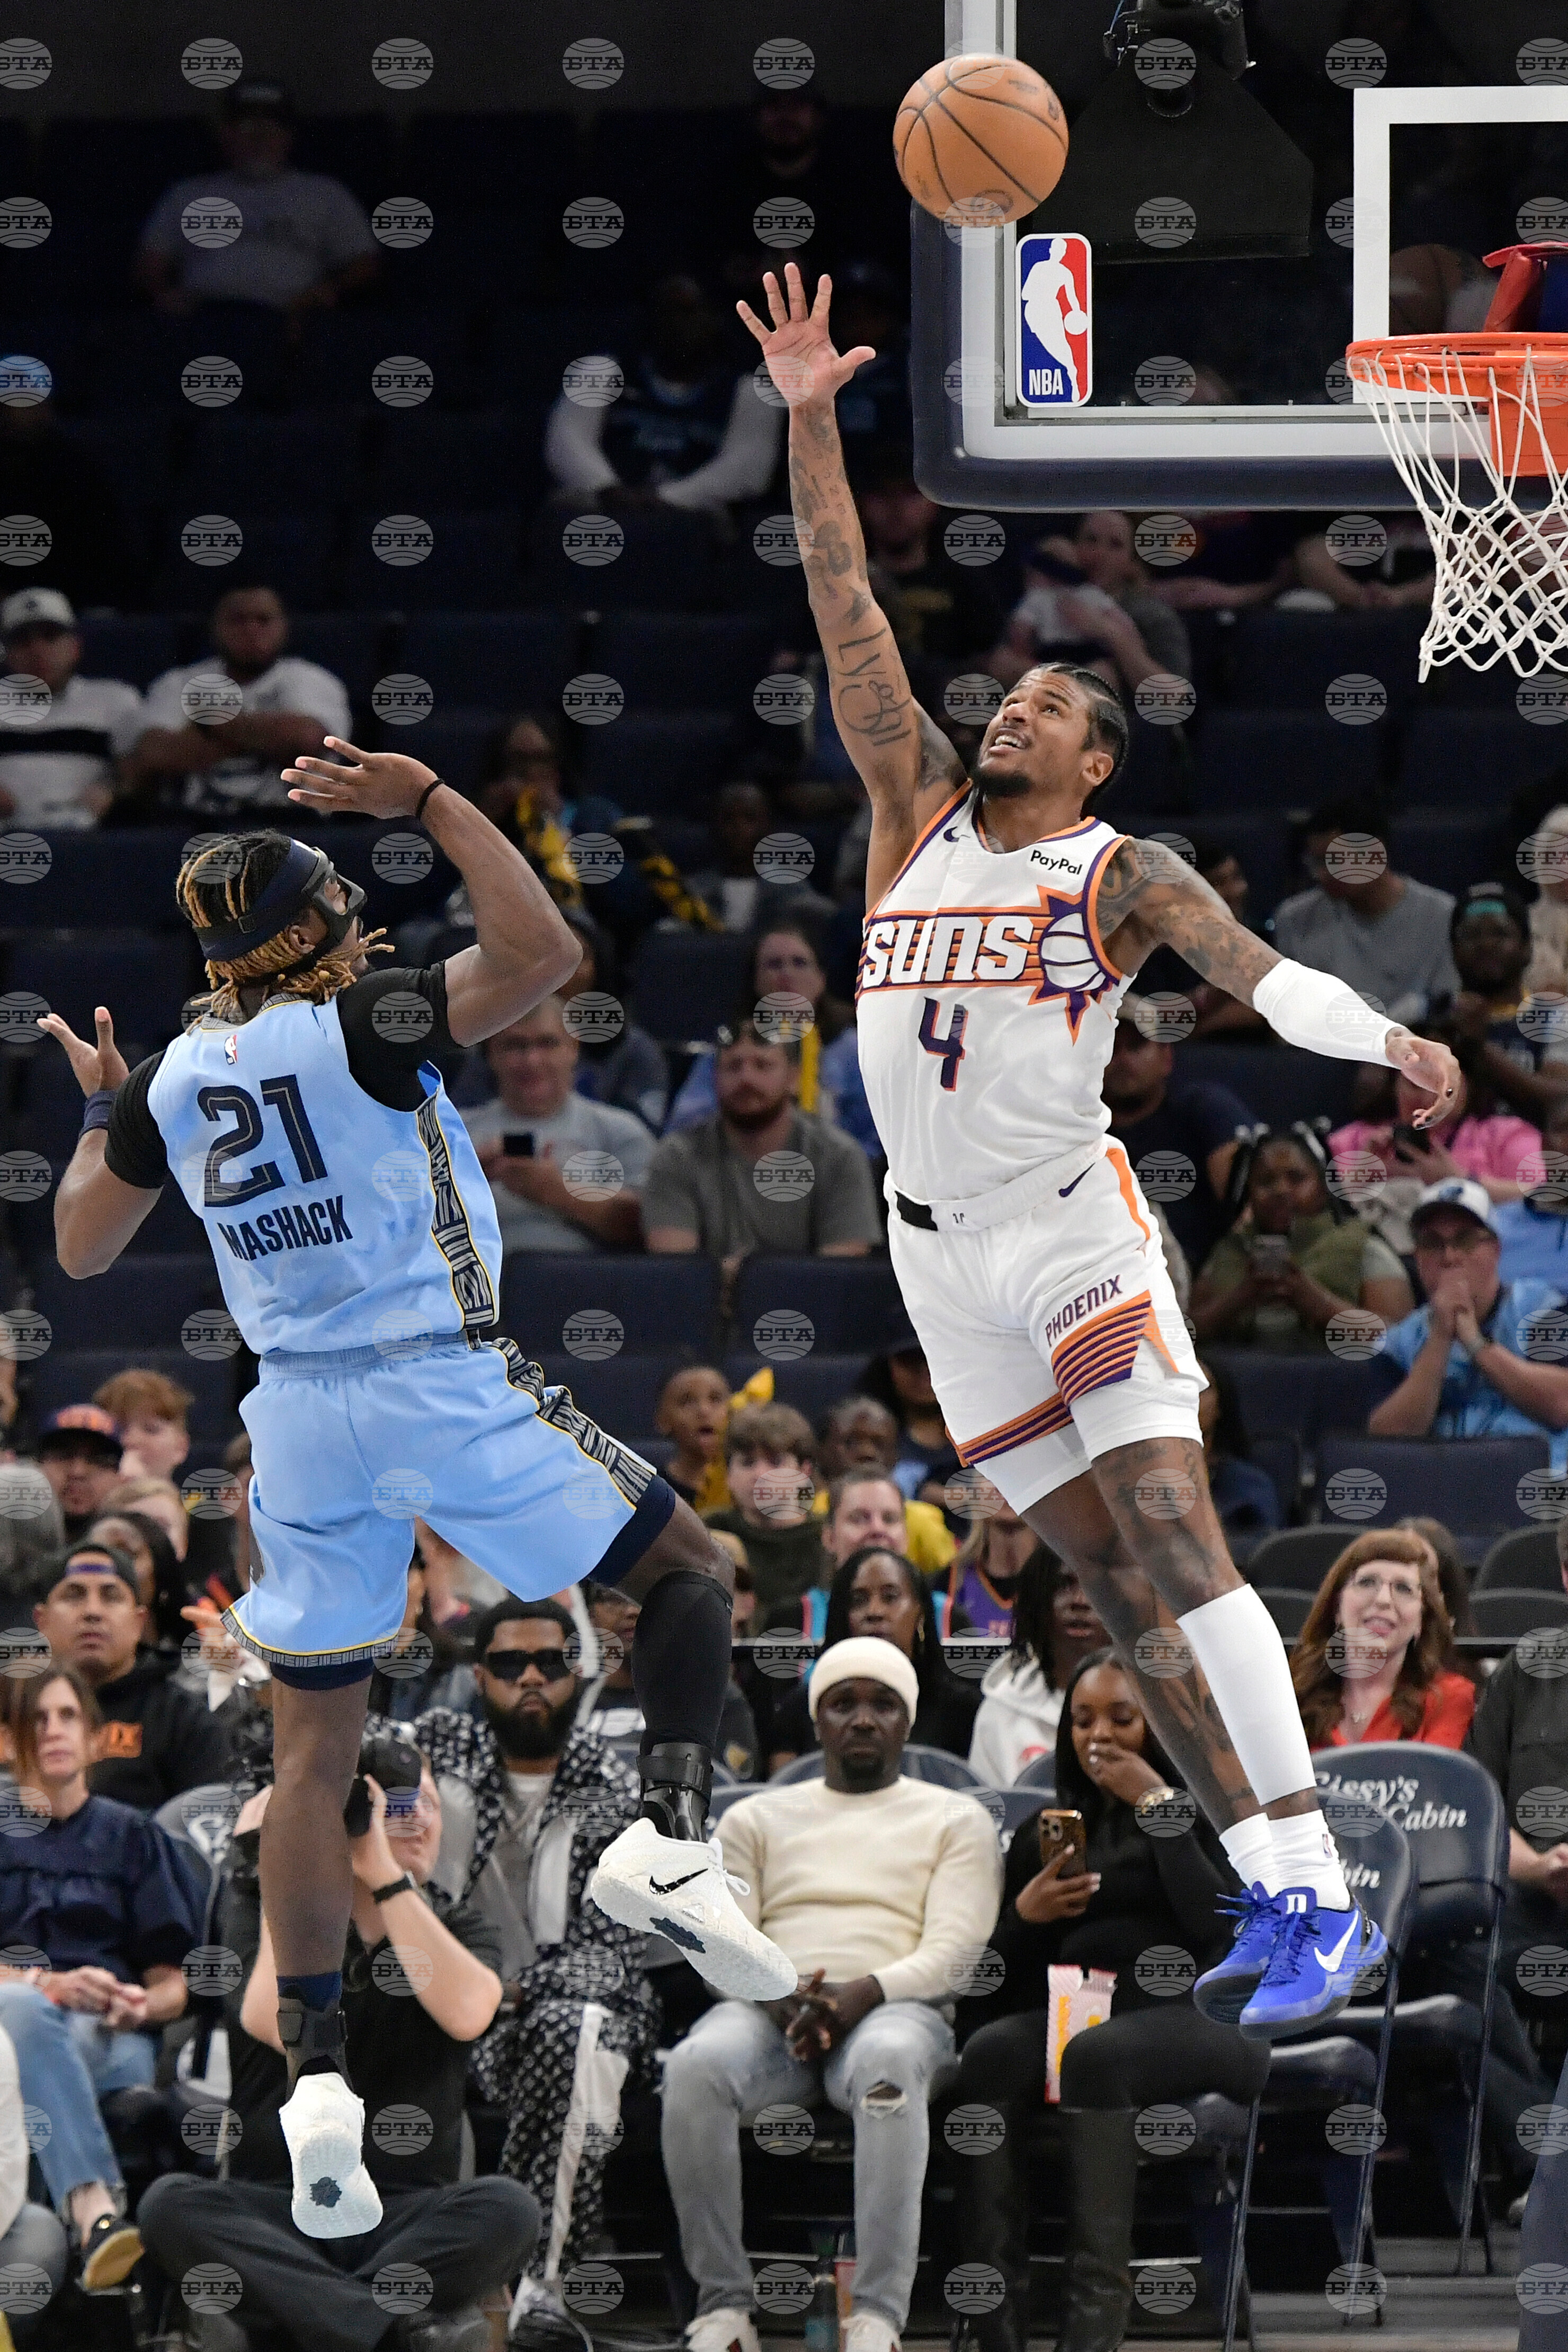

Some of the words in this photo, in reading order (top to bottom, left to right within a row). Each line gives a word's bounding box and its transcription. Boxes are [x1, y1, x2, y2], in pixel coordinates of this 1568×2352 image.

[1029, 369, 1064, 395] NBA
[1030, 849, 1083, 875] PayPal
[862, 915, 1034, 988] SUNS
[918, 996, 969, 1092] 4
[198, 1074, 328, 1207] 21
[217, 1195, 353, 1261] MASHACK
[1045, 1274, 1123, 1348] PHOENIX
